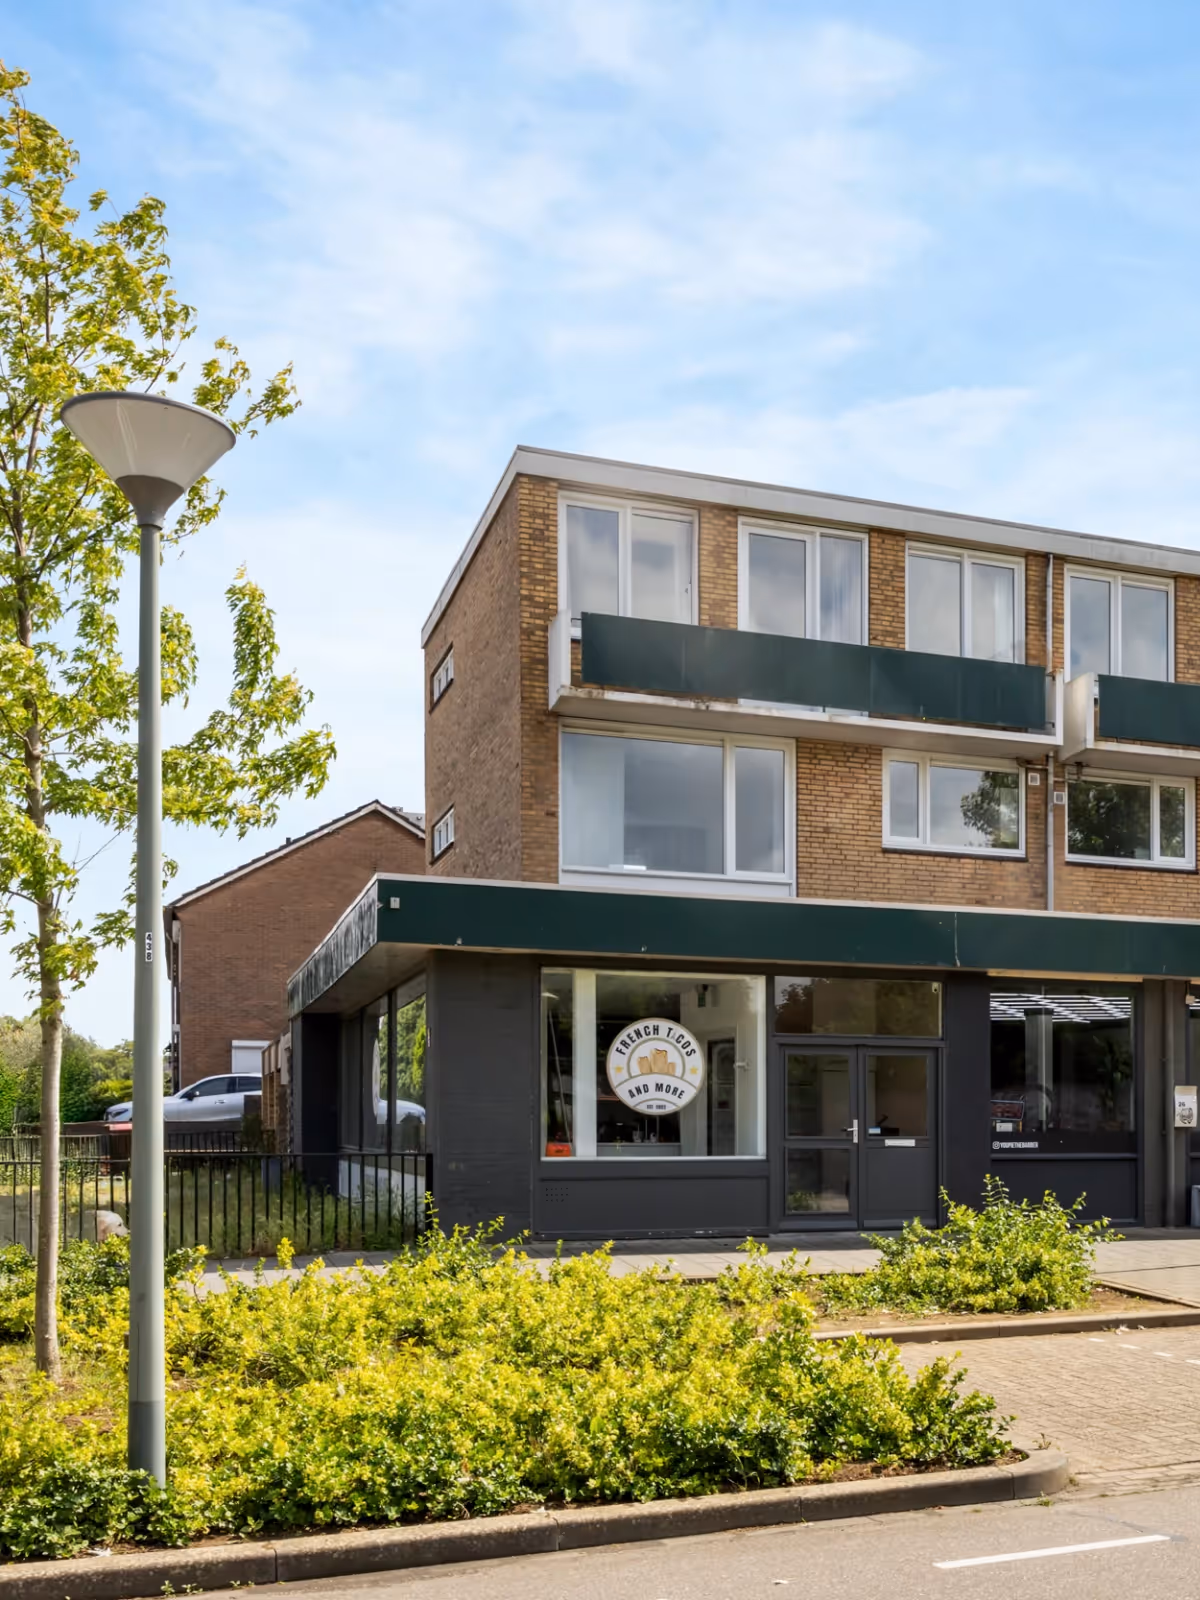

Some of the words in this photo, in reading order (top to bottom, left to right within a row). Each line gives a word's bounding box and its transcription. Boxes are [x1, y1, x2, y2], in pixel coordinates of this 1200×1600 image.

[615, 1025, 660, 1056] FRENCH
[666, 1027, 697, 1057] TACOS
[628, 1084, 649, 1099] AND
[655, 1083, 685, 1099] MORE
